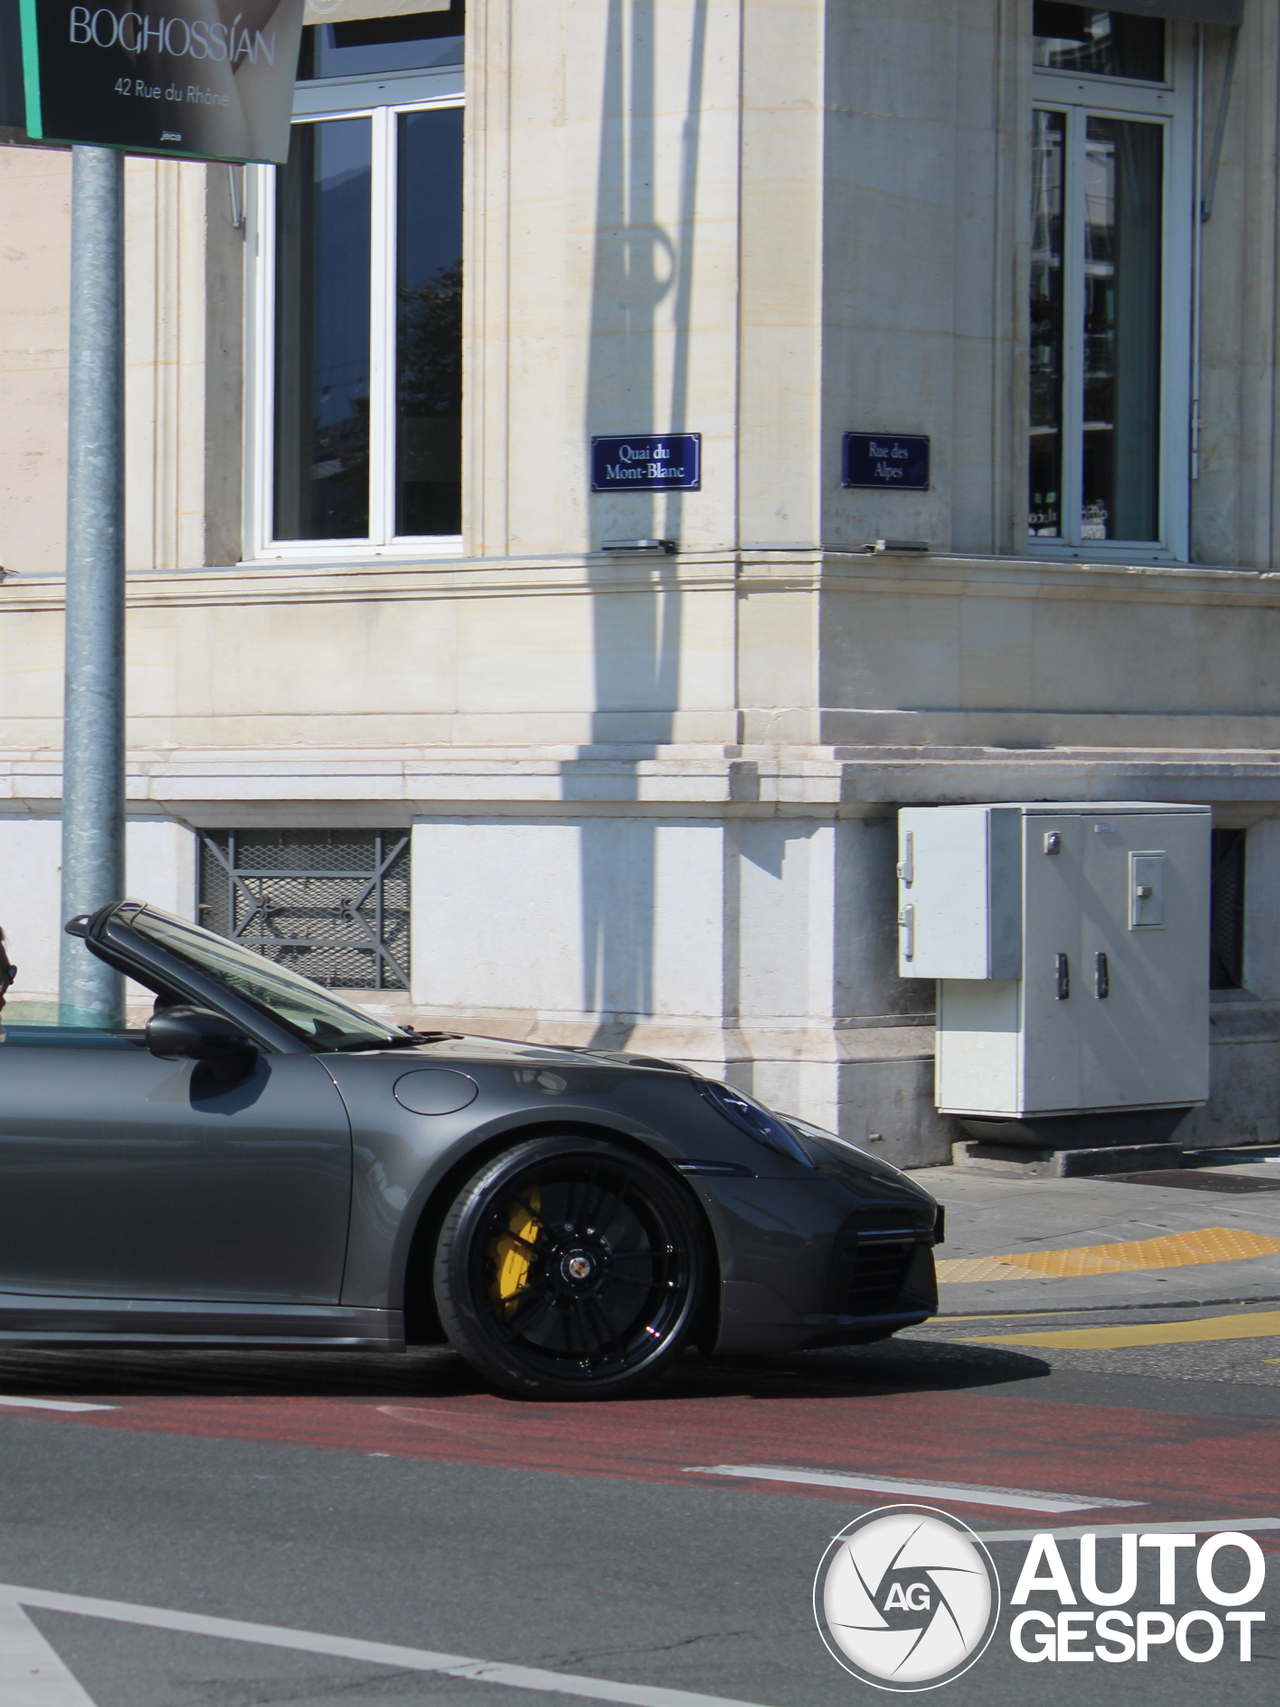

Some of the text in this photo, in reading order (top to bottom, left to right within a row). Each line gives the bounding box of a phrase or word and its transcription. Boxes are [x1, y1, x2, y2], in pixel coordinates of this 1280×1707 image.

[114, 77, 230, 107] 42 Rue du Rhône
[619, 443, 670, 463] Quai du
[869, 441, 909, 459] Rue des
[606, 462, 685, 480] Mont-Blanc
[874, 461, 903, 481] Alpes
